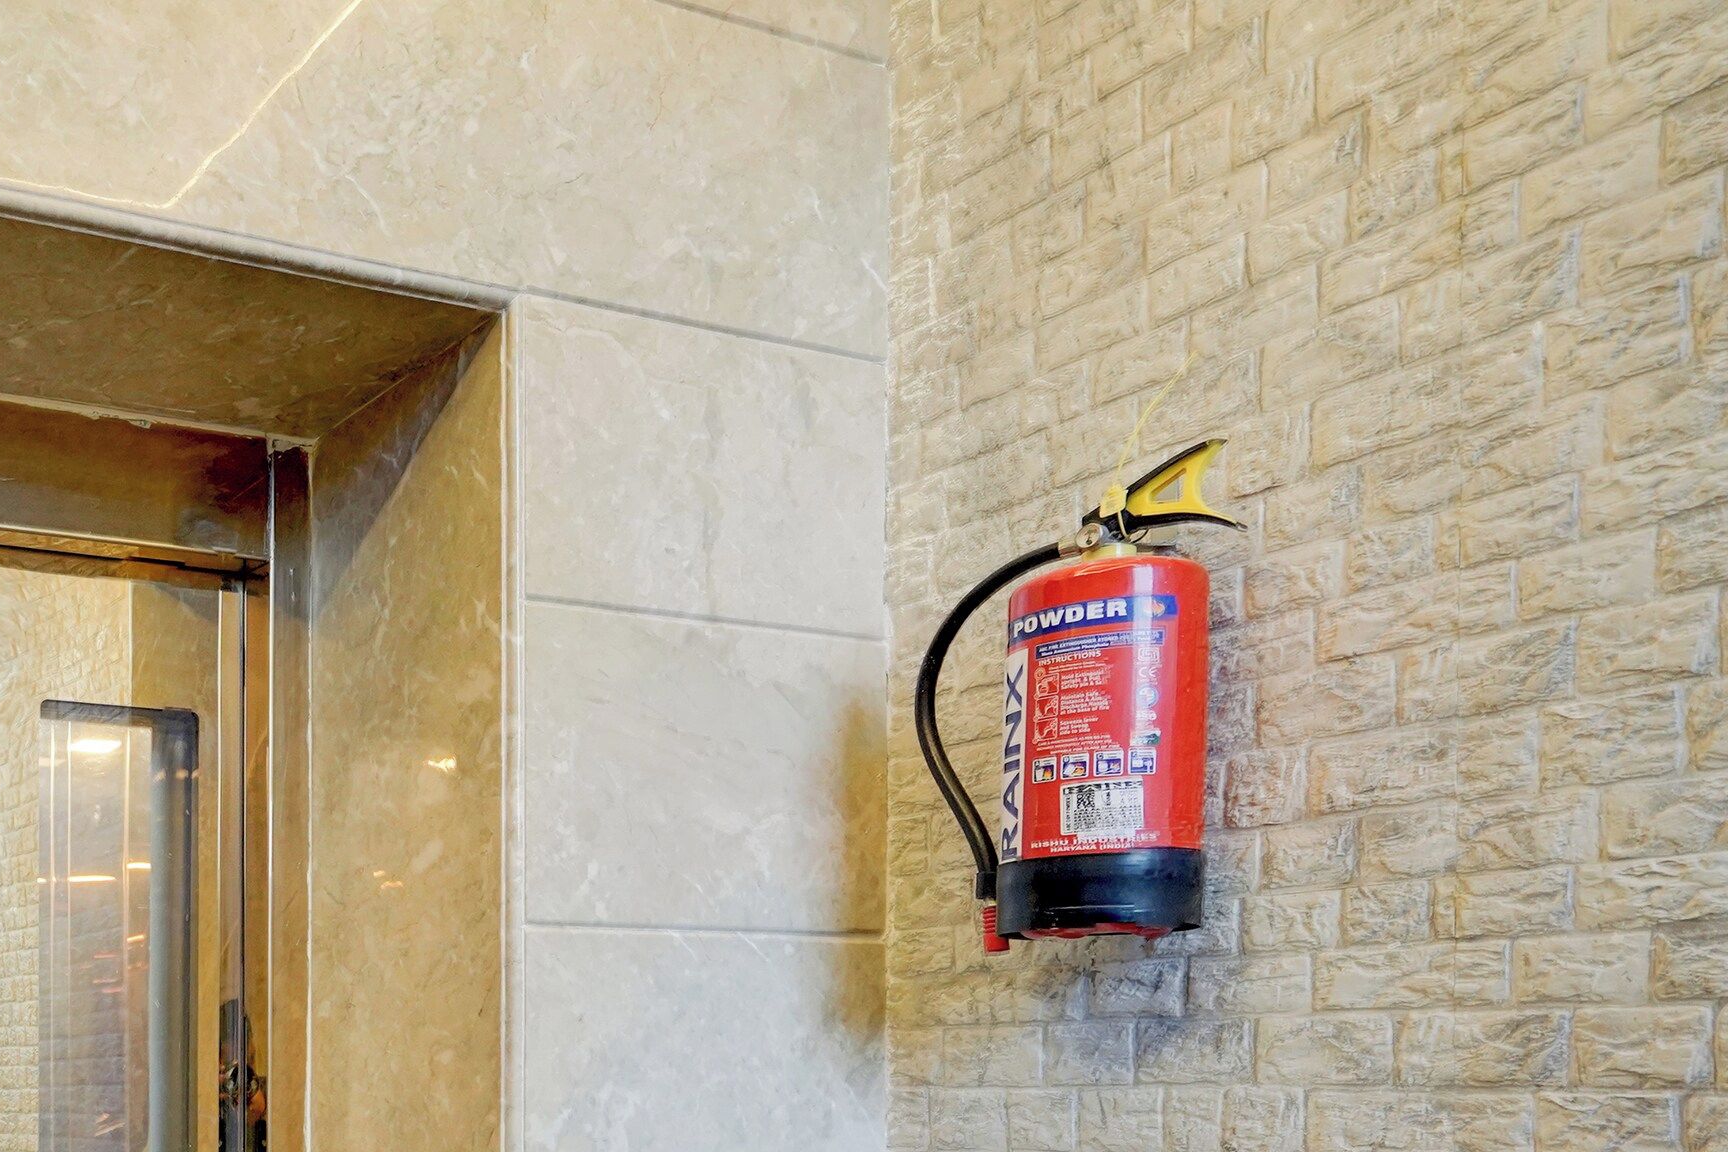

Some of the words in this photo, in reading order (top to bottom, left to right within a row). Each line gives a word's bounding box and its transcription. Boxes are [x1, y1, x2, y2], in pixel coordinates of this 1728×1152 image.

[1013, 598, 1127, 638] POWDER
[1038, 649, 1102, 666] INSTRUCTIONS
[1001, 664, 1023, 861] RAINX
[1031, 838, 1069, 849] RISHU
